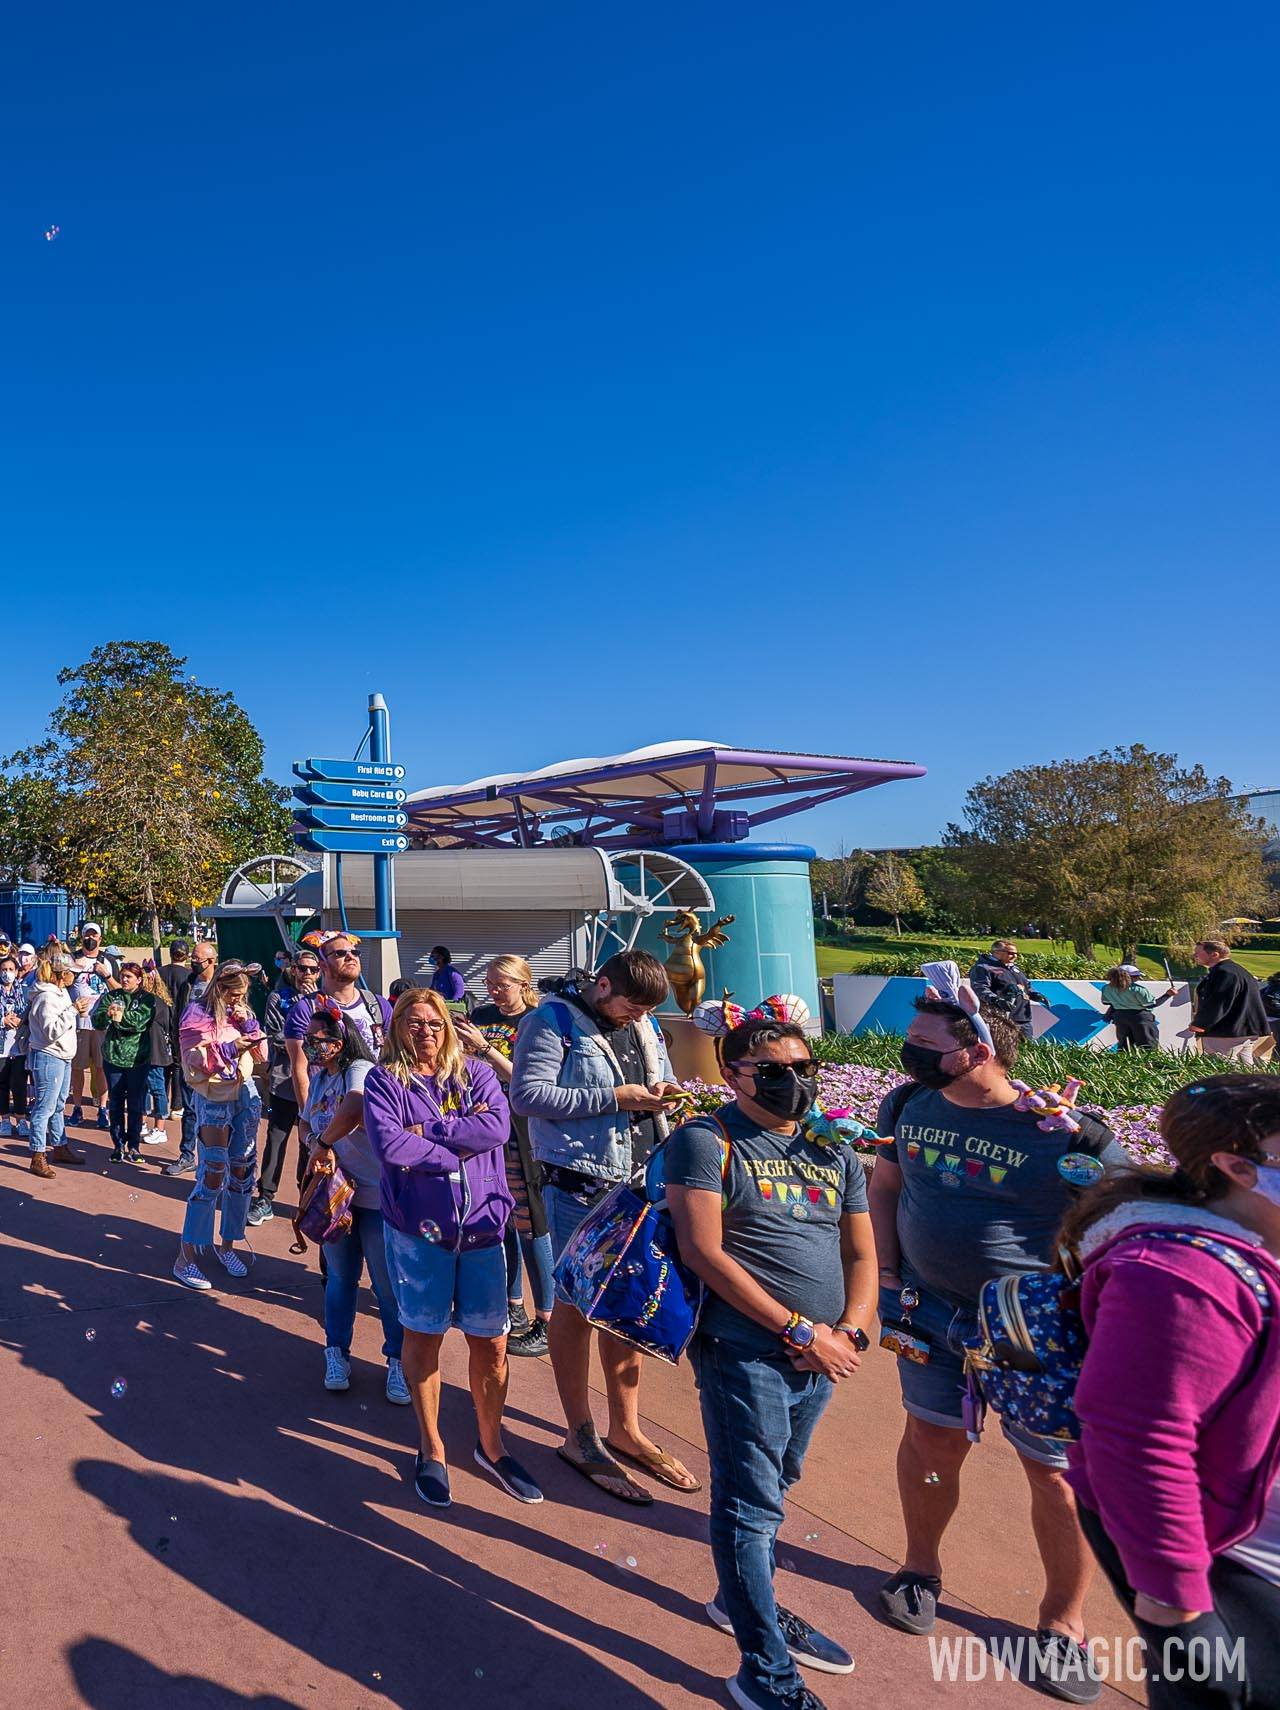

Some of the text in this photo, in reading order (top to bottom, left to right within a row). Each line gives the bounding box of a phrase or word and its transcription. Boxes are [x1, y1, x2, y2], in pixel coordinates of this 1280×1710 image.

[357, 765, 385, 775] First Aid
[352, 789, 385, 799] Baby Care
[351, 813, 386, 822] Restrooms
[901, 1124, 1029, 1169] FLIGHT CREW
